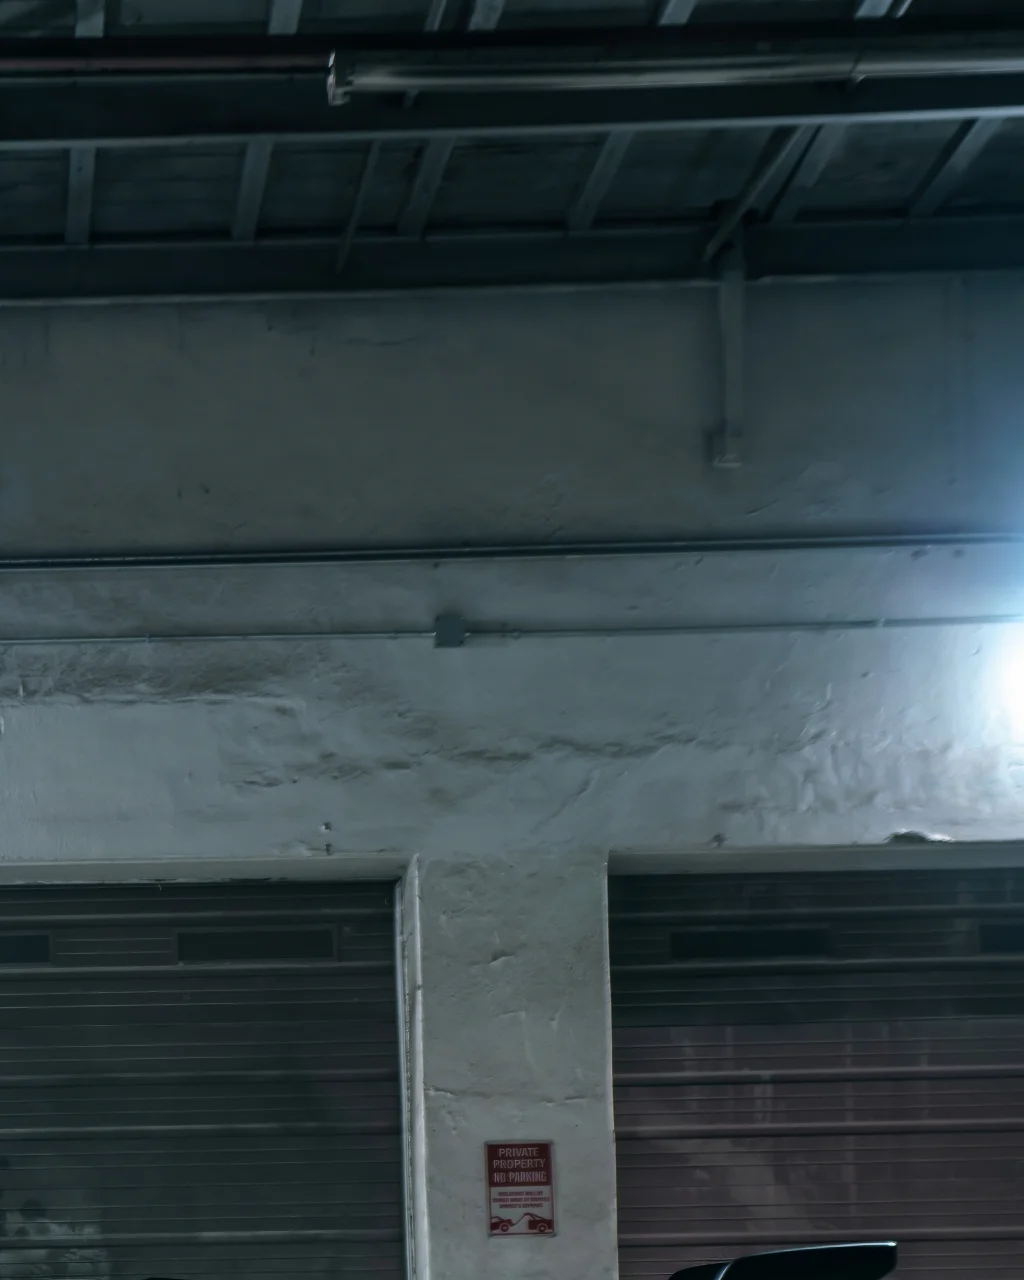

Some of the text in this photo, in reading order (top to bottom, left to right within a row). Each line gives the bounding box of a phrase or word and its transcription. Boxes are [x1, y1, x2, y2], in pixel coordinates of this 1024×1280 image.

[498, 1147, 539, 1158] PRIVATE
[493, 1158, 546, 1169] PROPERTY
[494, 1170, 547, 1183] NO PARKING
